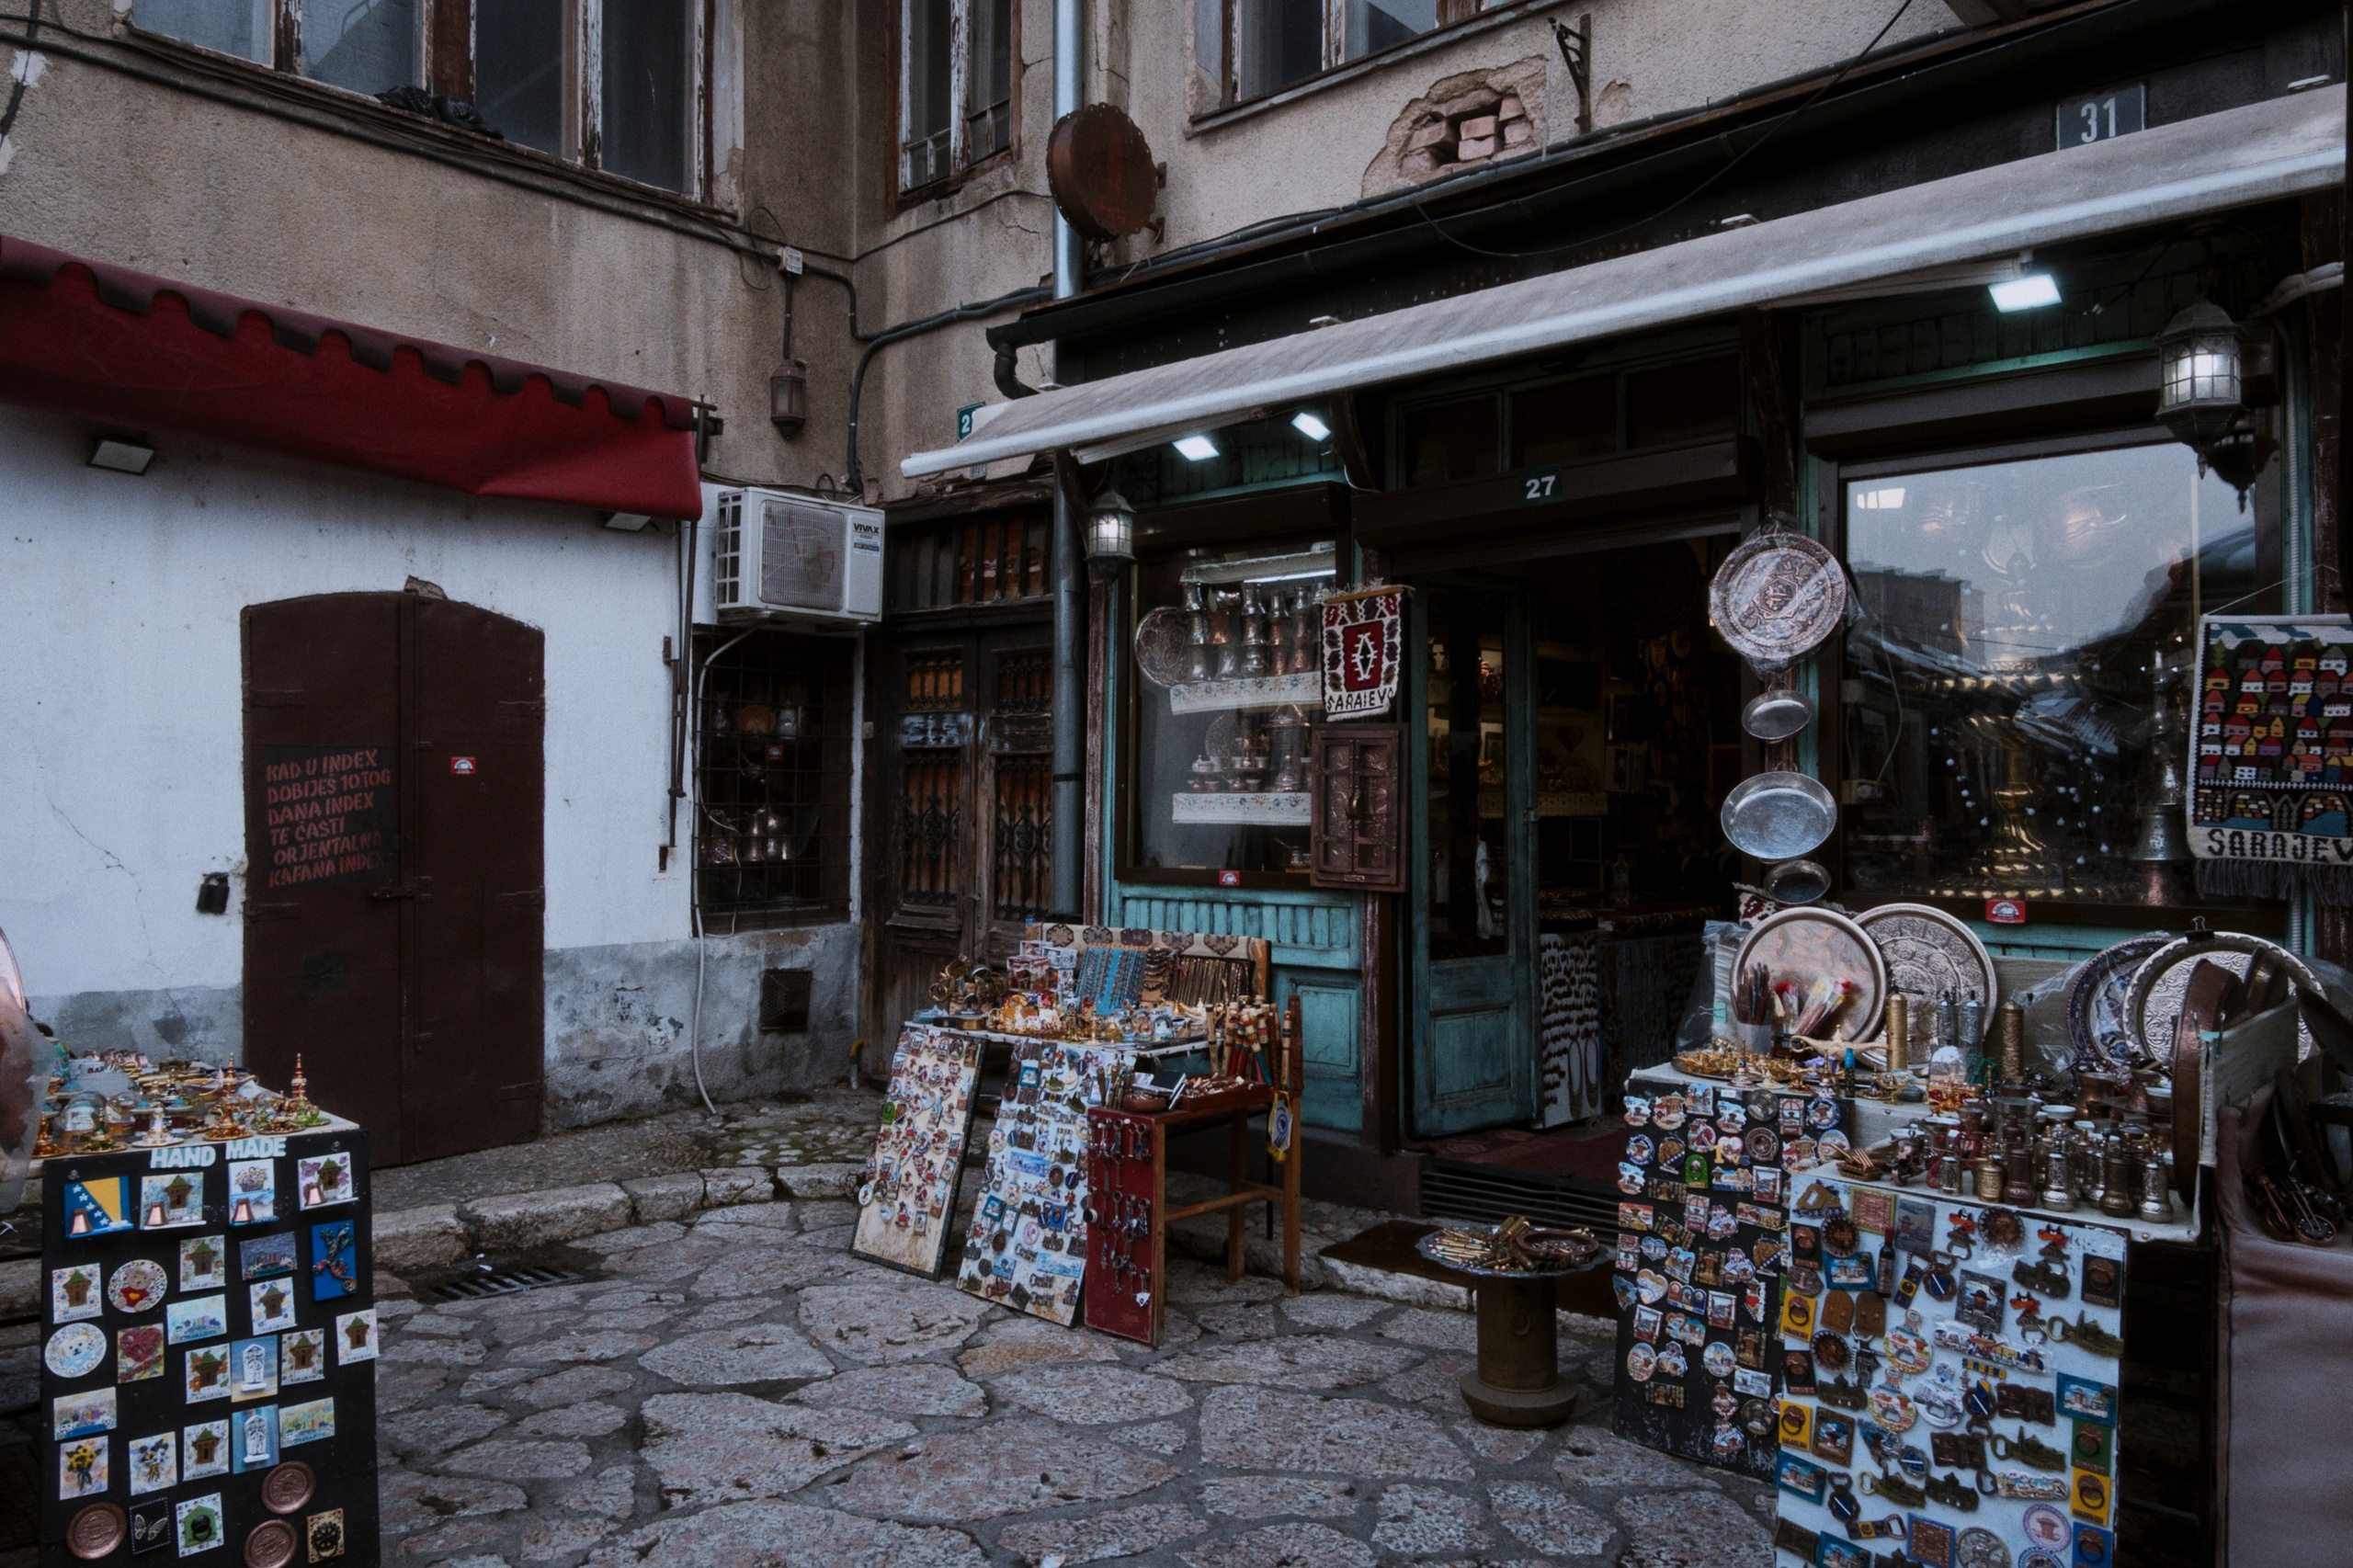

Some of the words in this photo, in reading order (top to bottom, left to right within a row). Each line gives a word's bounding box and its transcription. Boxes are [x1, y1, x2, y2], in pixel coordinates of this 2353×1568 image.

[2080, 97, 2116, 142] 31
[1525, 474, 1556, 499] 27
[853, 523, 880, 535] VIVAX
[267, 762, 301, 782] KAD
[306, 758, 318, 777] U
[323, 749, 378, 774] INDEX
[267, 773, 336, 804] DOBIJEŠ
[267, 801, 322, 826] DANA
[325, 791, 375, 816] INDEX
[270, 826, 290, 846] TE
[295, 815, 346, 842] ČASTI
[2207, 828, 2353, 862] SARAJEV
[268, 859, 336, 889] KAFANA
[340, 852, 383, 873] INDEX
[150, 1145, 218, 1169] HAND
[225, 1137, 288, 1160] MADE
